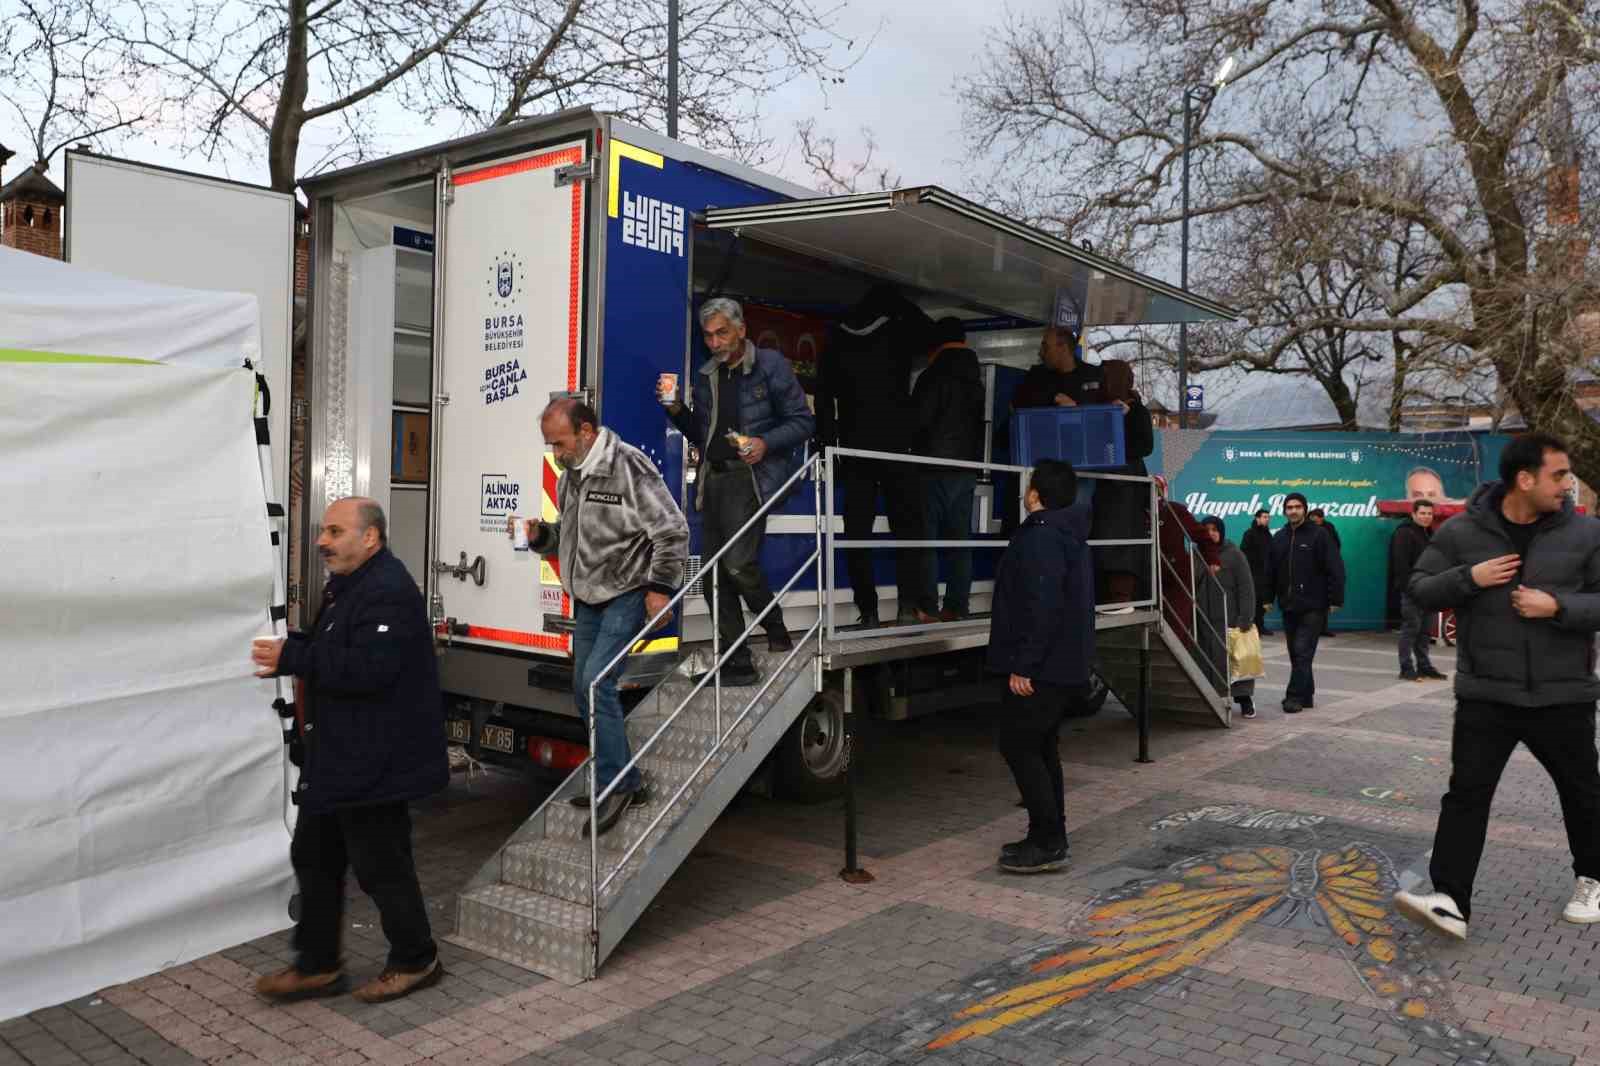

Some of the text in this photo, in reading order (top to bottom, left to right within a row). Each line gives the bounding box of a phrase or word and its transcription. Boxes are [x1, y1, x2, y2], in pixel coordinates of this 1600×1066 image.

[485, 315, 523, 329] BURSA
[485, 328, 523, 340] BÜYÜKŞEHİR
[485, 338, 523, 351] BELEDİYESİ
[485, 359, 519, 380] BURSA
[491, 369, 527, 390] CANLA
[486, 384, 519, 404] BAŞLA
[485, 481, 519, 495] ALİNUR
[486, 497, 517, 511] AKTAŞ
[1185, 492, 1379, 520] Hayırlı Rmazanl
[452, 721, 464, 738] 16
